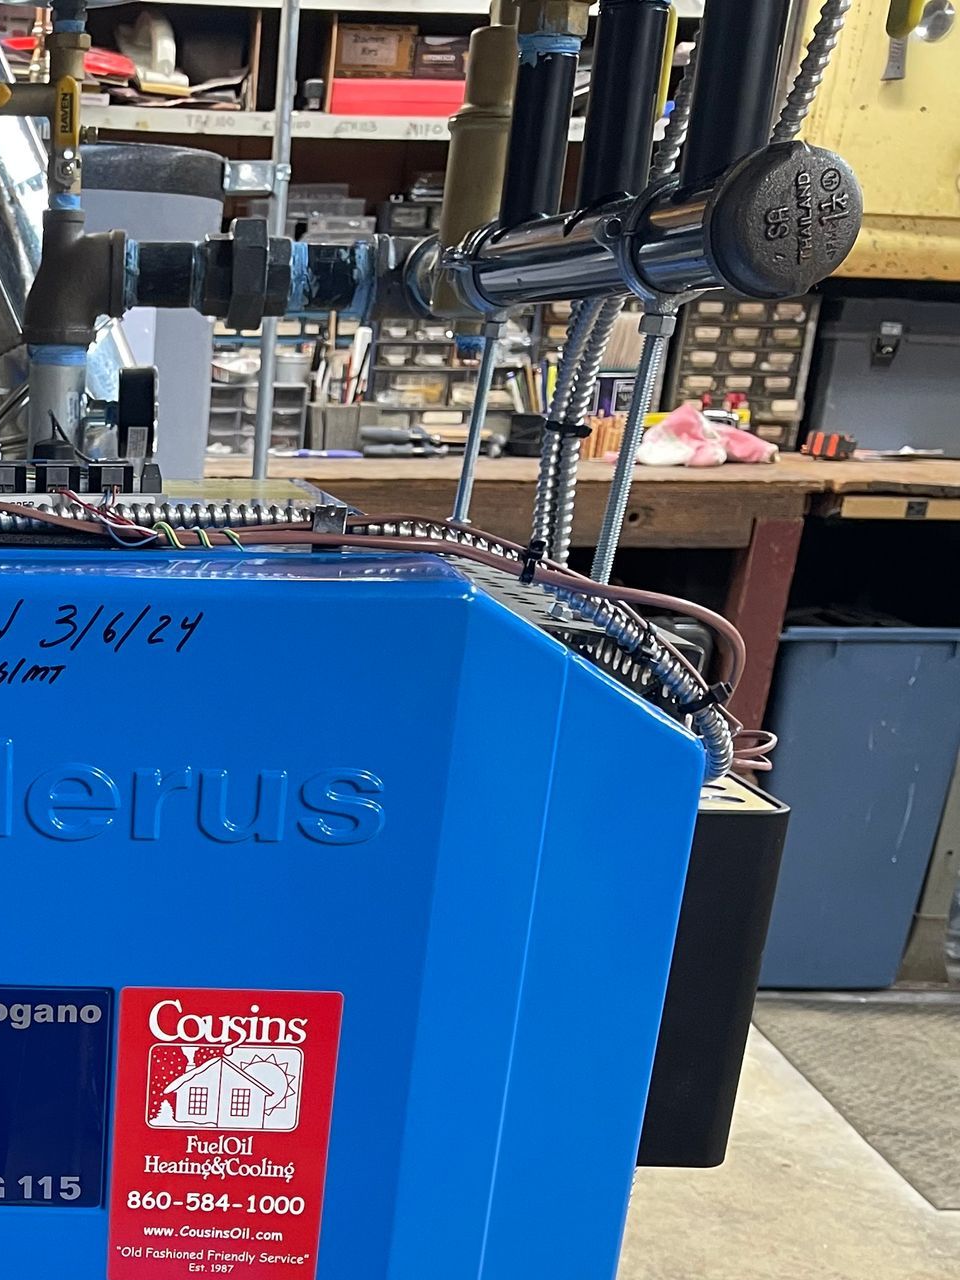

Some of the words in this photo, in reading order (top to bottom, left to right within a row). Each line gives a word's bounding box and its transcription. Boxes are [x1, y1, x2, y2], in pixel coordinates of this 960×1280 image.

[60, 92, 70, 133] RAVEN
[797, 172, 813, 262] THAILAND
[39, 603, 204, 653] 3/6/24
[148, 999, 309, 1054] Cousins
[186, 1135, 254, 1156] FuelOil
[144, 1156, 296, 1183] Heating&Cooling
[18, 1176, 82, 1200] 115
[126, 1190, 306, 1216] 860-584-1000
[143, 1225, 284, 1242] www.CousinsOil.com
[146, 1246, 203, 1261] Fashioned
[207, 1249, 255, 1265] Friendly
[188, 1262, 207, 1273] Est.
[210, 1263, 234, 1273] 1987
